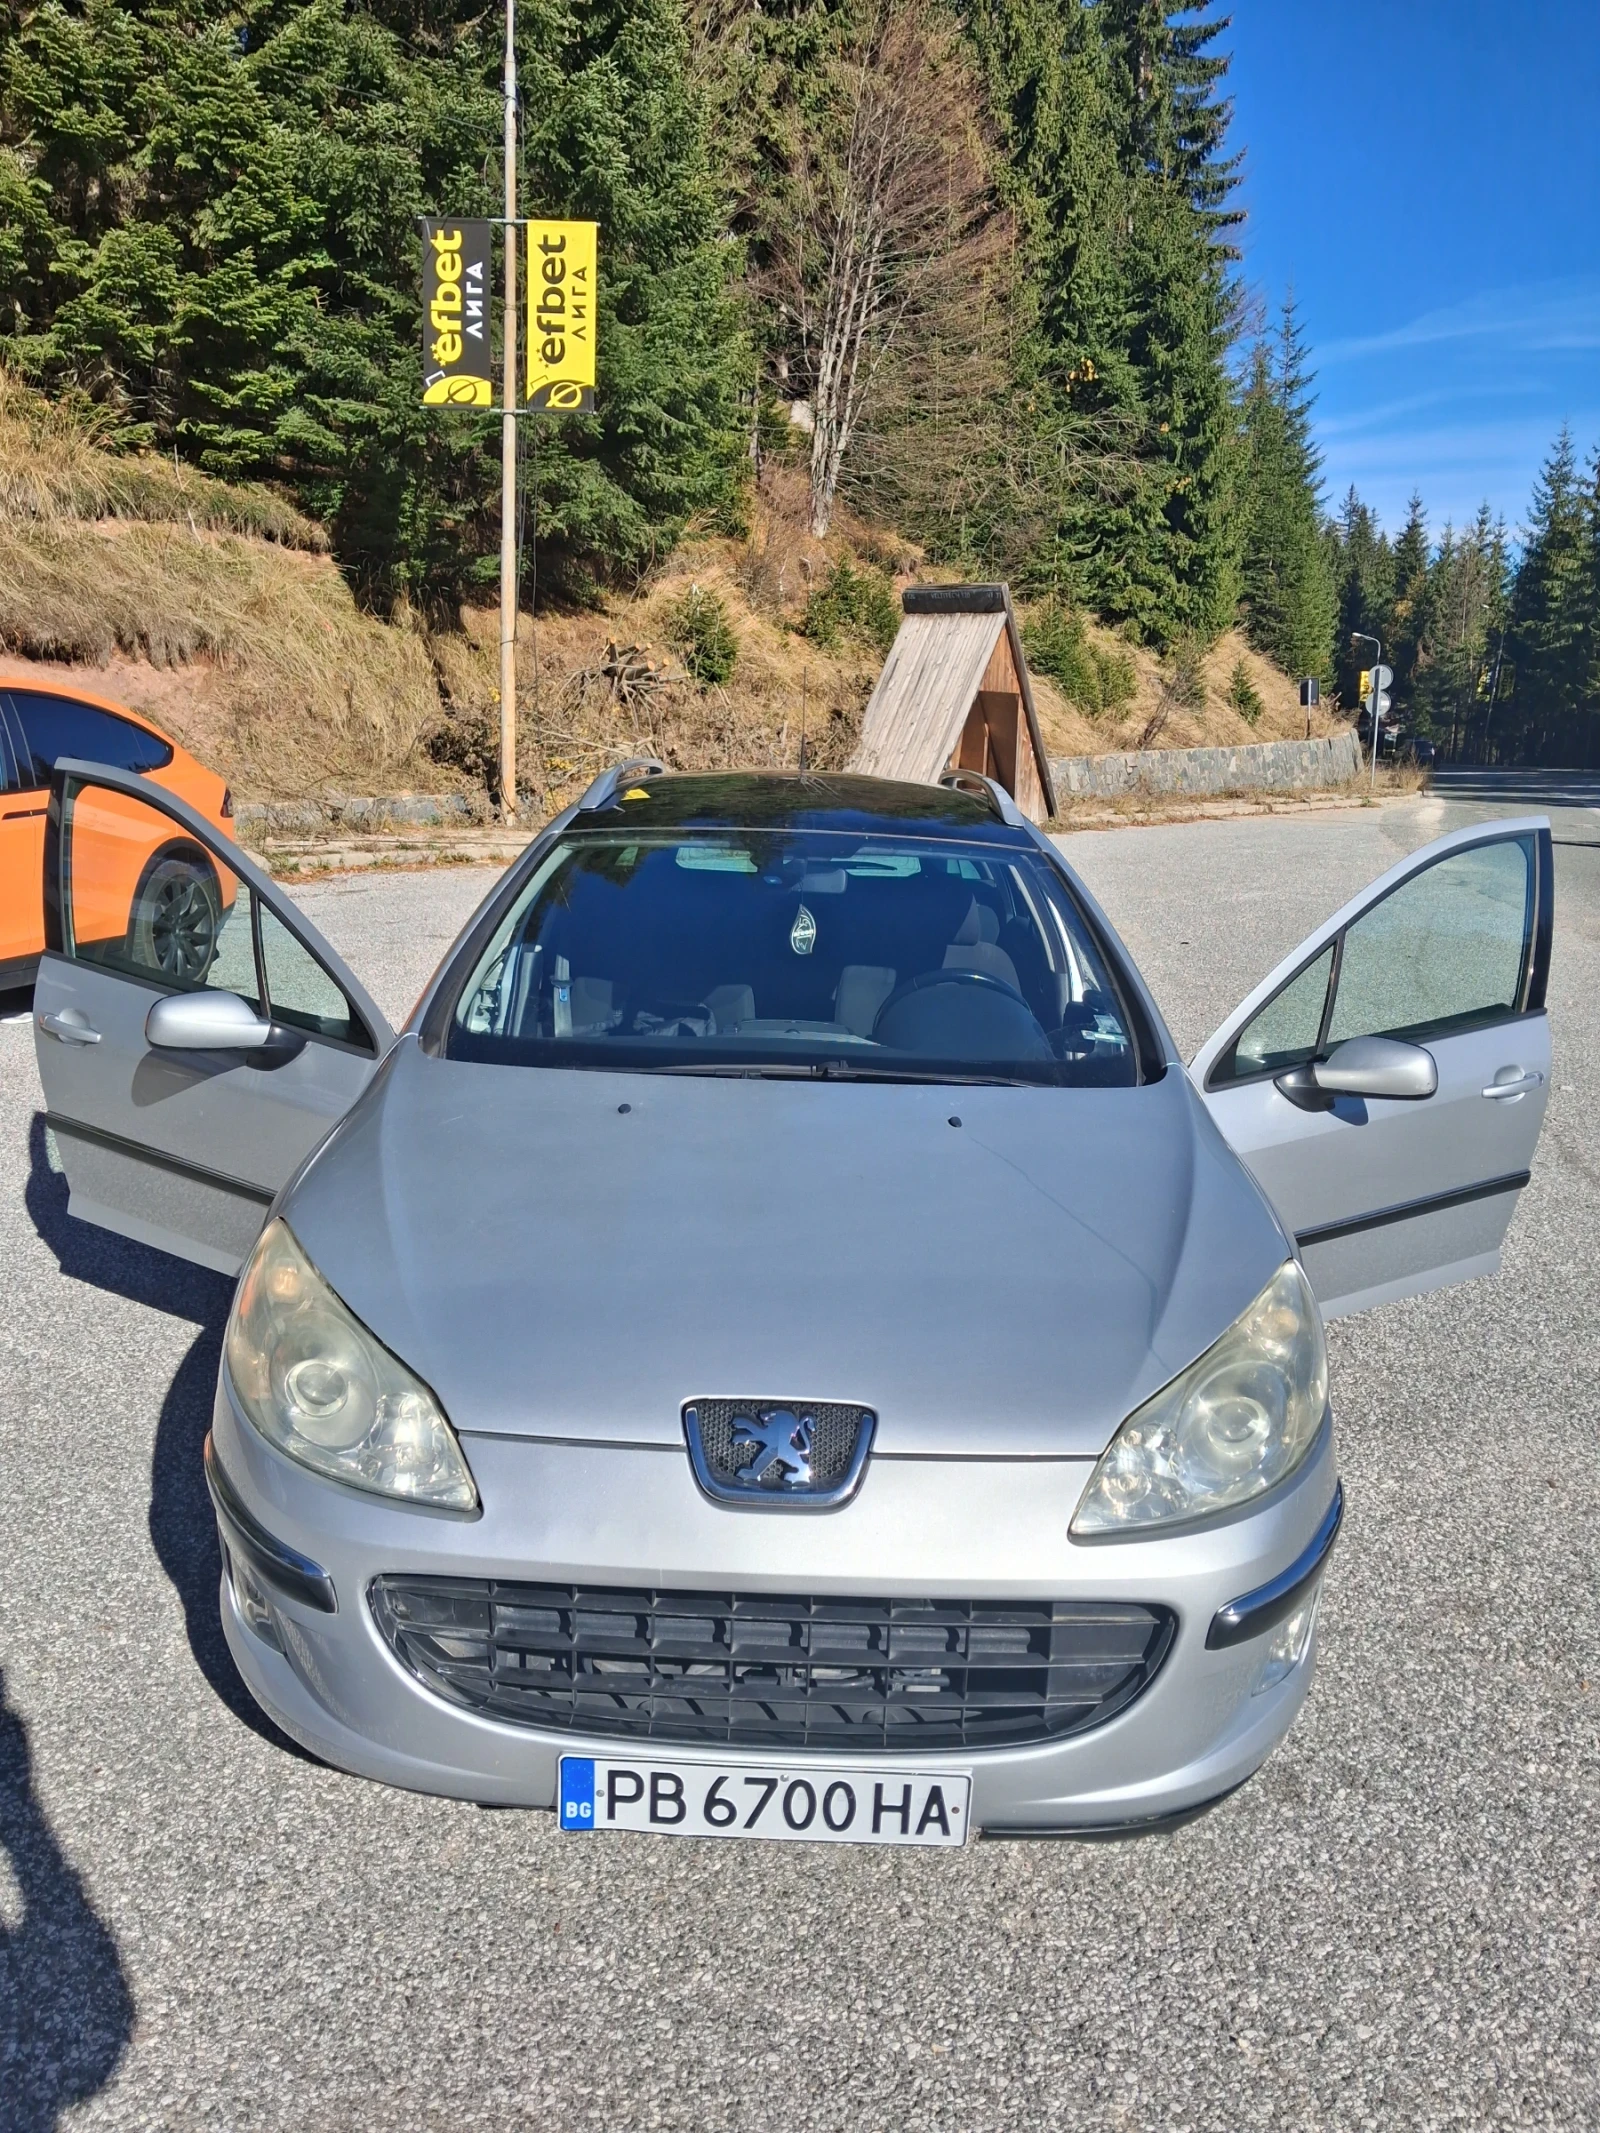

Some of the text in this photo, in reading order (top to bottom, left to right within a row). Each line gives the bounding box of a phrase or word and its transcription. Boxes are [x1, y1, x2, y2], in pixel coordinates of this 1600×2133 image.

[430, 229, 462, 362] efbet
[466, 261, 483, 340] ЛИГА
[536, 234, 566, 364] efbet
[571, 266, 587, 341] ЛИГА
[566, 1801, 592, 1818] BG
[606, 1769, 952, 1837] PB 6700 HA
